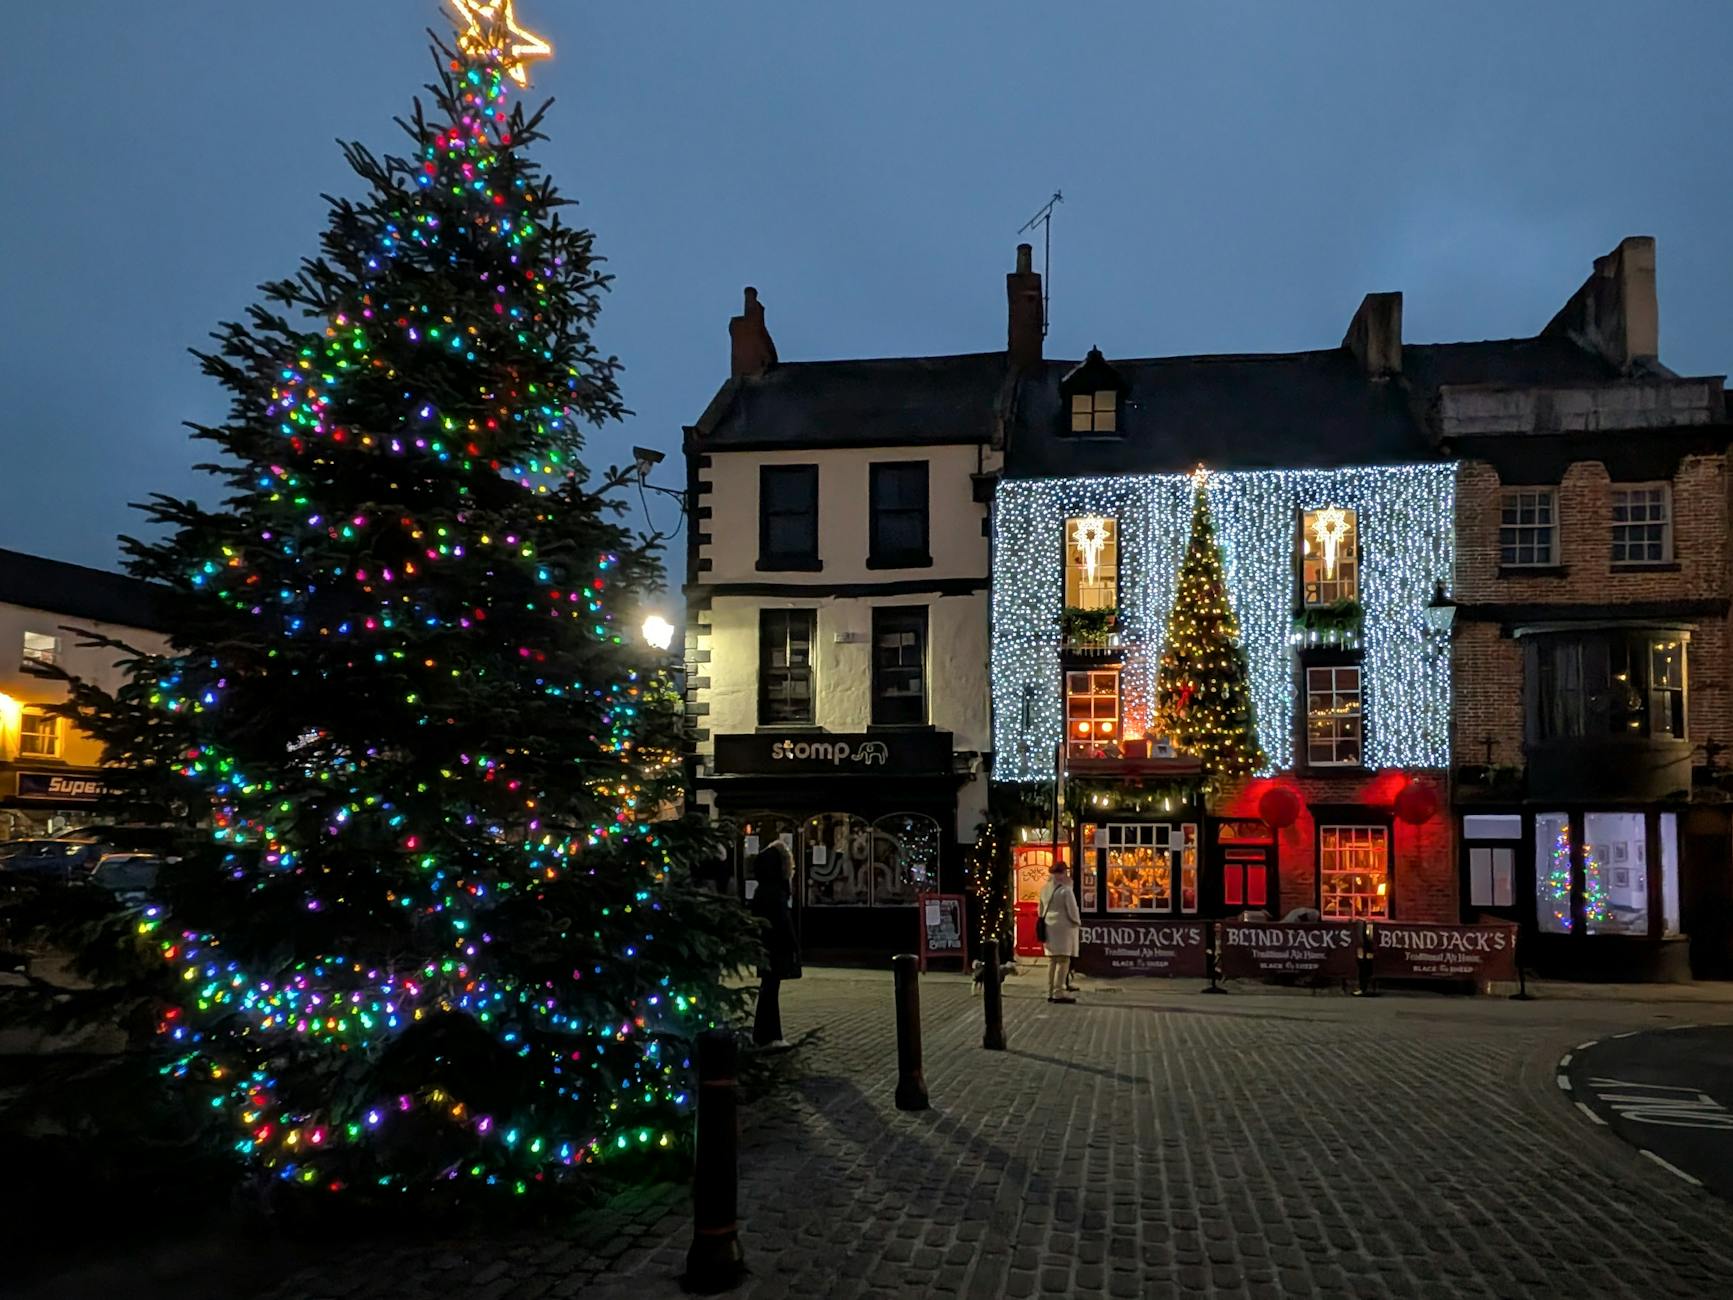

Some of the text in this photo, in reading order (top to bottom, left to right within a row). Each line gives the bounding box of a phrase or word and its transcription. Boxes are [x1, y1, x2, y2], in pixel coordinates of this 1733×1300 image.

[772, 740, 850, 765] stomp
[1080, 926, 1201, 947] BLIND JACK'S
[1226, 928, 1352, 949] BLIND JACK'S
[1378, 930, 1438, 949] BLIND
[1440, 931, 1506, 951] JACK'S
